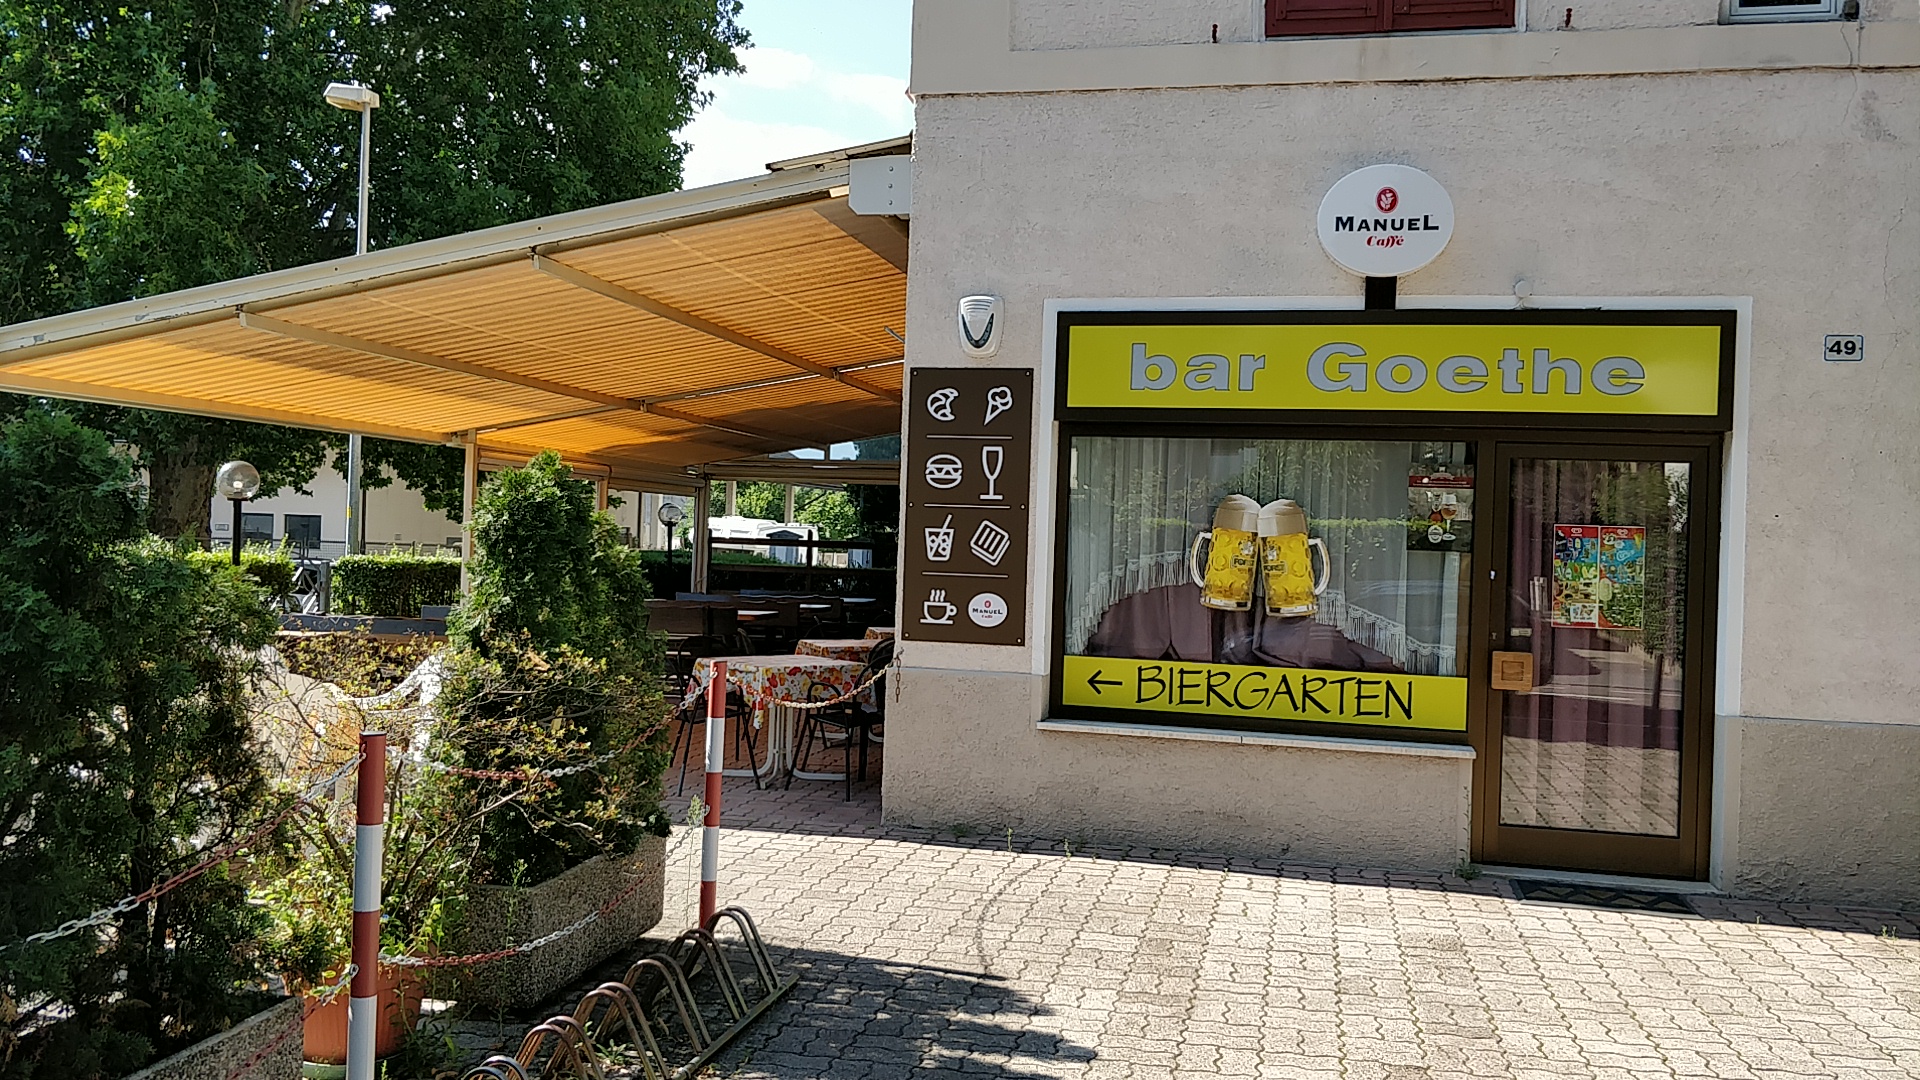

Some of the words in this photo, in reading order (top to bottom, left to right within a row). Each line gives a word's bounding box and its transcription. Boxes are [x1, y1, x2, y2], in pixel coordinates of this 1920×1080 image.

[1334, 214, 1439, 232] MANUEL
[1828, 340, 1857, 356] 49
[1130, 343, 1266, 391] bar
[1306, 342, 1646, 395] Goethe
[972, 607, 1003, 615] MANUEL
[1135, 665, 1413, 720] BIERGARTEN
